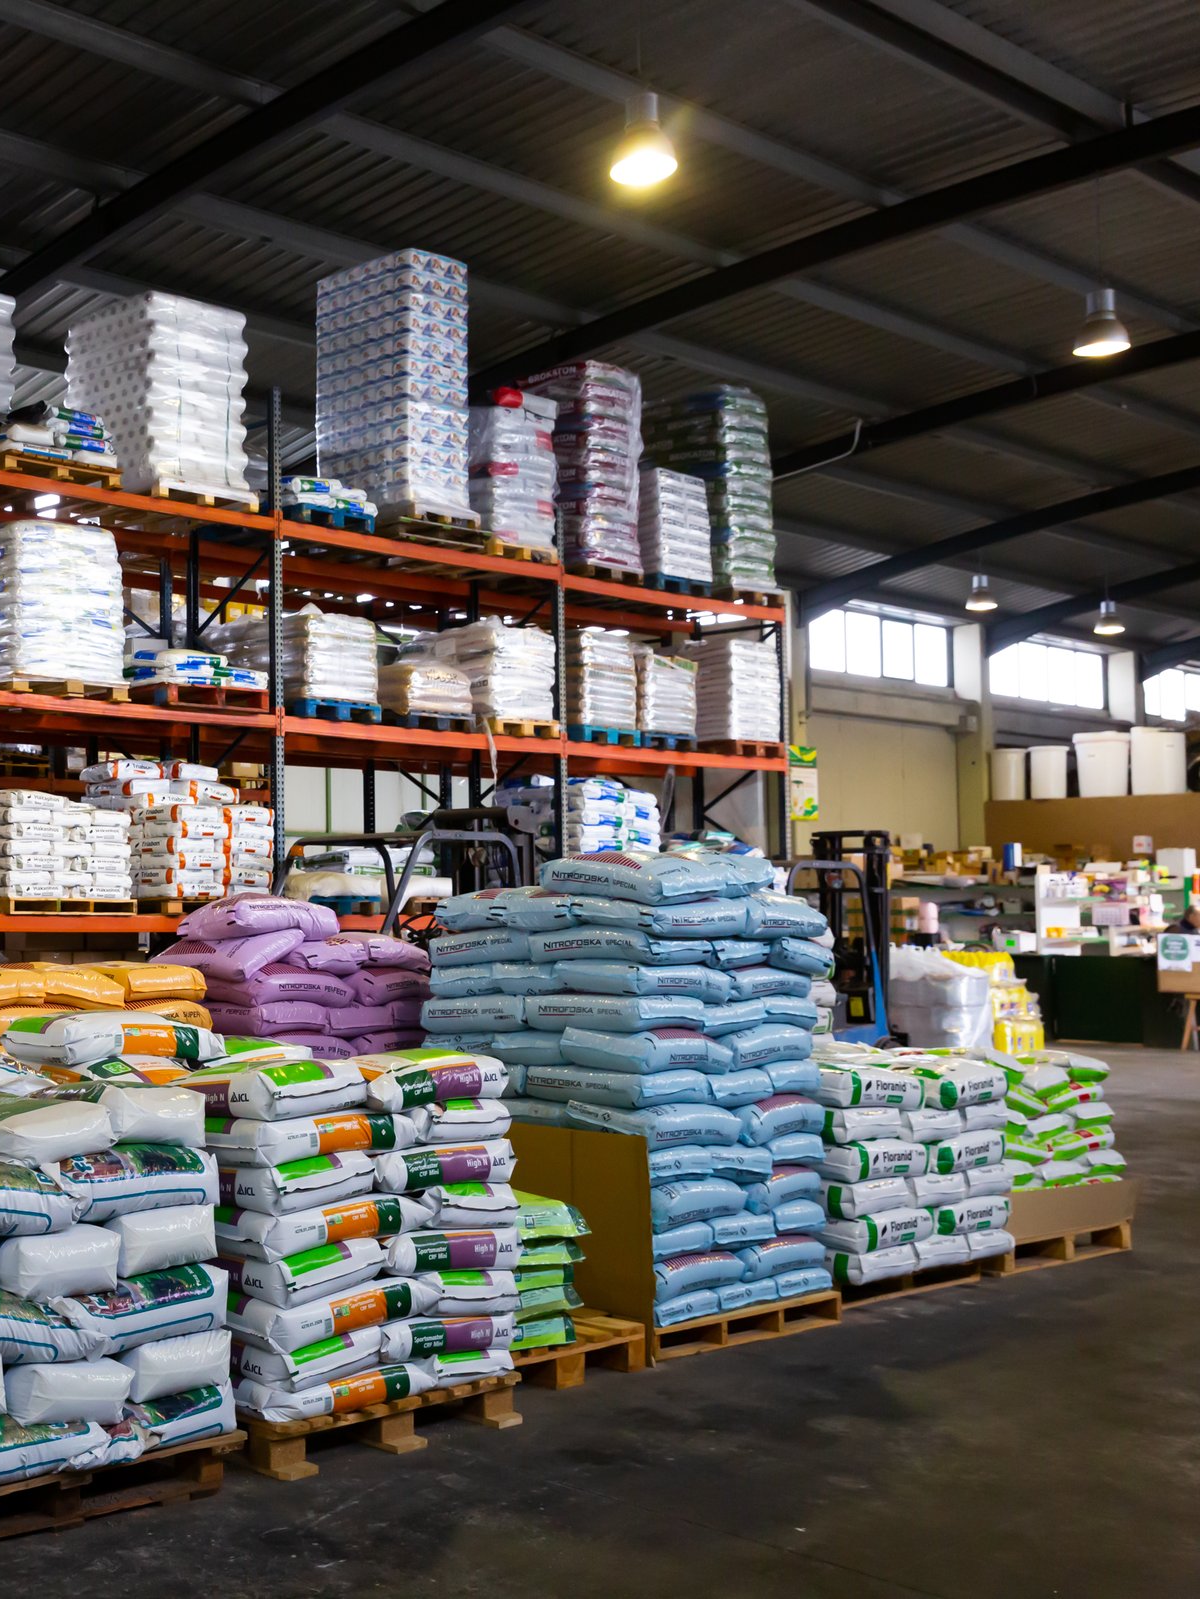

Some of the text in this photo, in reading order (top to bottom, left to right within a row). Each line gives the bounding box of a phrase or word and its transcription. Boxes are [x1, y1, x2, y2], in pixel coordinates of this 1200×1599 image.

[528, 366, 577, 384] BROKATON
[552, 870, 638, 891] NITROFOSKA SPECIAL
[761, 919, 805, 928] NITROFOSKA
[436, 937, 512, 954] NITROFOSKA SPECIAL
[544, 938, 632, 950] NITROFOSKA SPECIAL
[279, 983, 321, 991] NITROFOSKA
[657, 976, 702, 986] NITROFOSKA
[752, 981, 792, 990] NITROFOSKA
[183, 1010, 201, 1018] SUPER
[226, 1008, 250, 1016] PERFECT
[428, 1008, 478, 1016] NITROFOSKA
[538, 1005, 593, 1014] NITROFOSKA
[740, 1046, 781, 1059] NITROFOSKA
[459, 1072, 479, 1085] High N
[527, 1075, 610, 1091] NITROFOSKA SPECIAL
[968, 1077, 994, 1090] Floranid
[876, 1080, 907, 1092] Floranid
[656, 1129, 702, 1139] NITROFOSKA
[883, 1149, 912, 1162] Floranid
[965, 1143, 990, 1157] Floranid
[467, 1157, 488, 1169] High N
[967, 1206, 993, 1221] Floranid
[891, 1217, 918, 1231] Floranid
[474, 1244, 494, 1254] High N
[471, 1328, 491, 1339] High N
[434, 1340, 443, 1348] Mini
